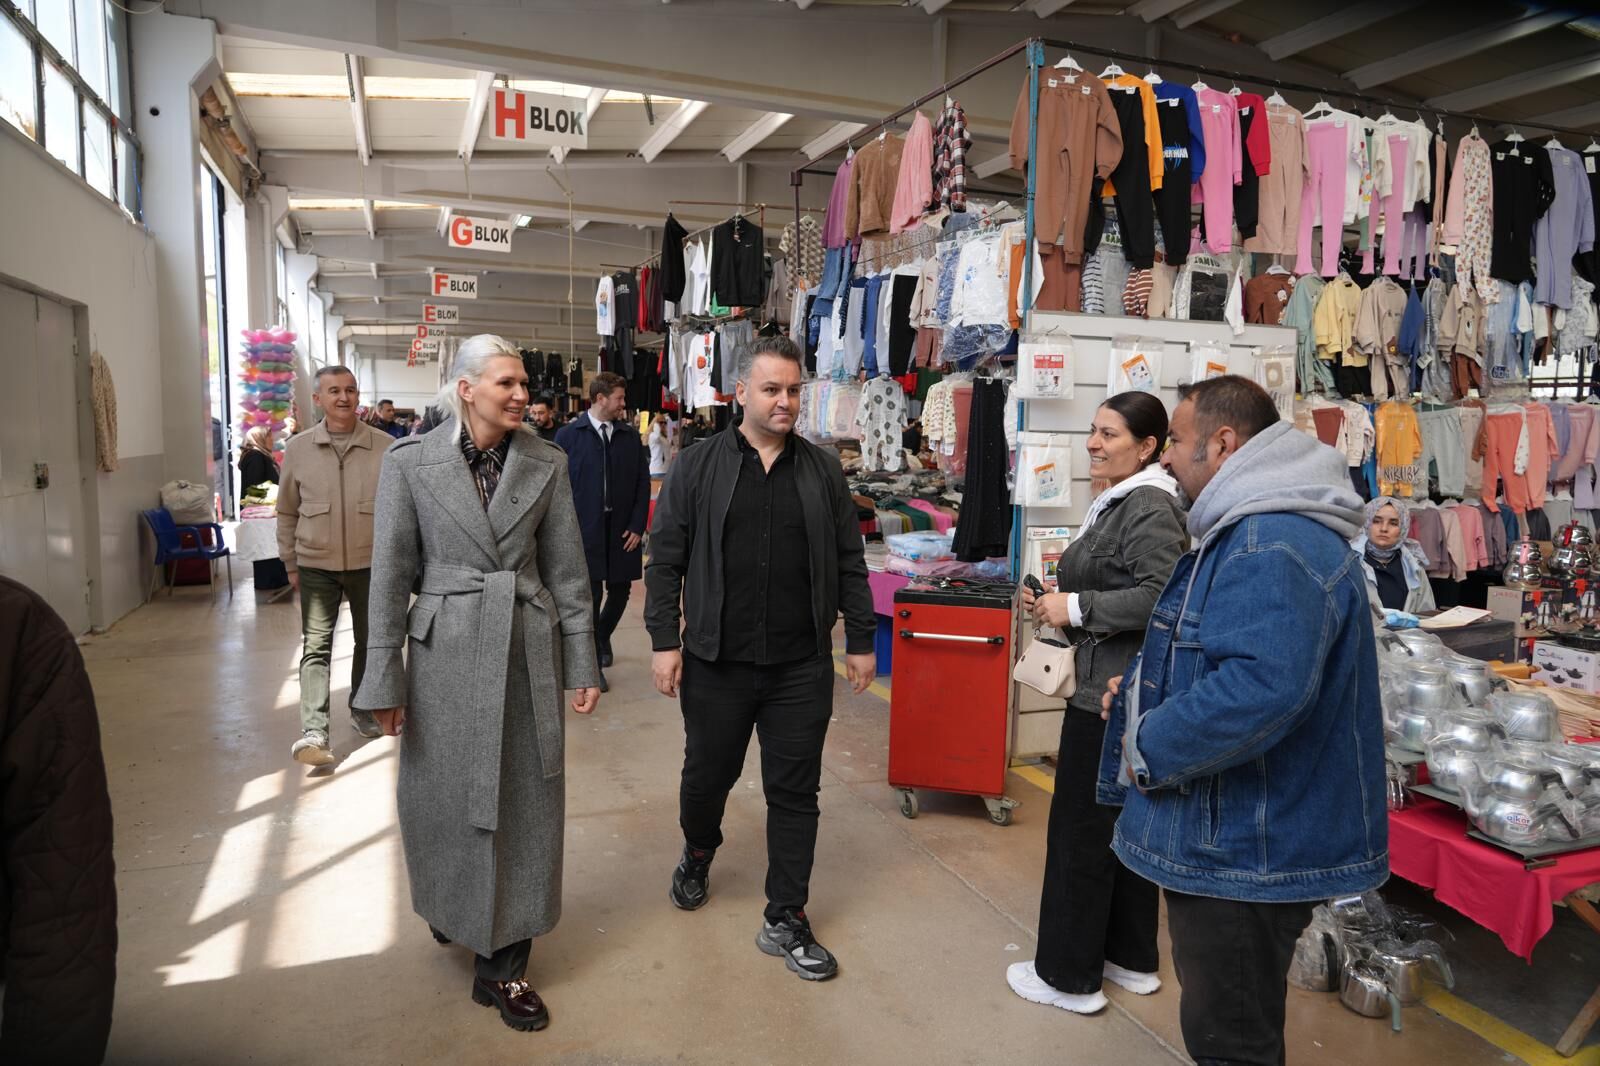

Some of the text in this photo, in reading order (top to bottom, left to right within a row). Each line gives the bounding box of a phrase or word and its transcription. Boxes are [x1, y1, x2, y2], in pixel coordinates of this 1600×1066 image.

[495, 90, 584, 139] H BLOK
[451, 217, 509, 246] G BLOK
[434, 274, 475, 295] F BLOK
[424, 305, 457, 322] E BLOK
[417, 325, 445, 338] D BLOK
[413, 339, 422, 351] C
[409, 349, 417, 359] B
